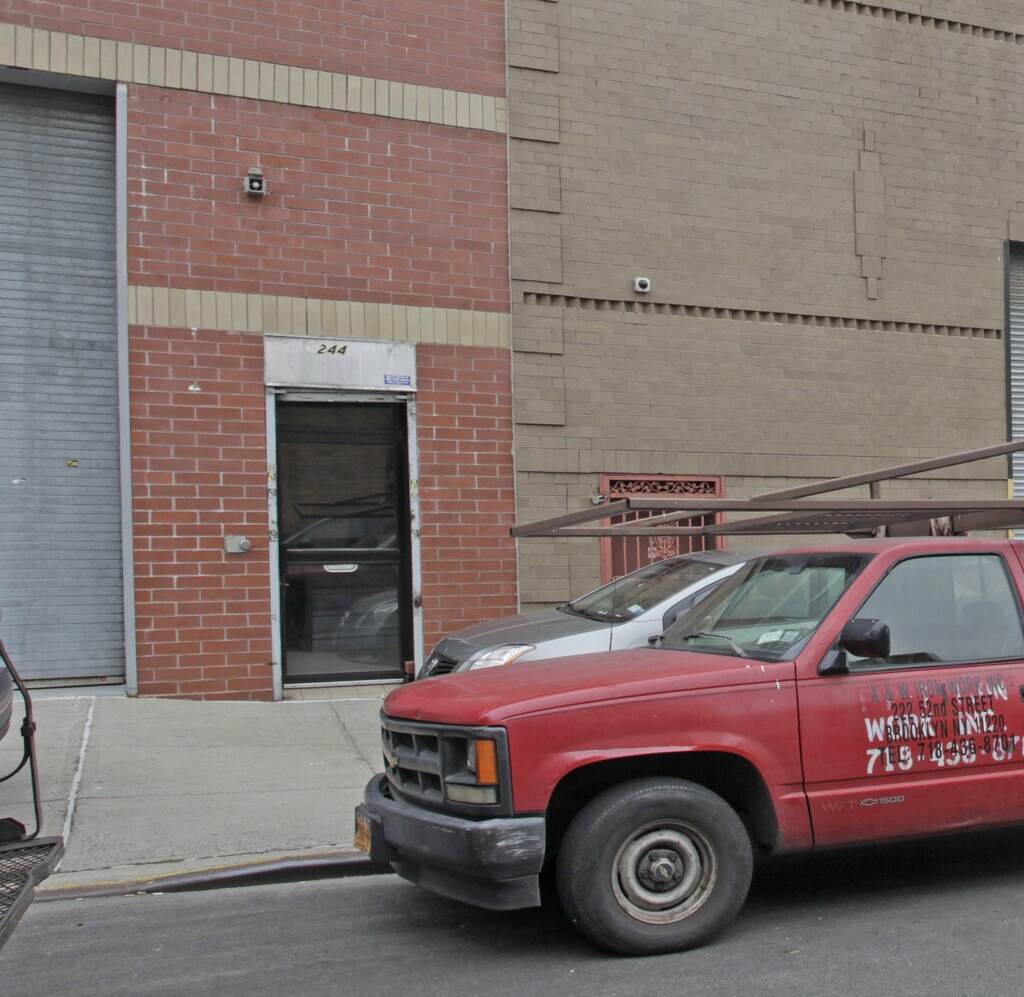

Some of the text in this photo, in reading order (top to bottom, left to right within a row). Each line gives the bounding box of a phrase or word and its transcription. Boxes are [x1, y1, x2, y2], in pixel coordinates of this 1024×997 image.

[317, 344, 347, 355] 244
[891, 702, 914, 721] 222
[919, 698, 947, 719] 52nd
[951, 694, 994, 716] STREET
[885, 714, 1006, 744] BROOKLYN NY 11220
[879, 795, 905, 804] 1500
